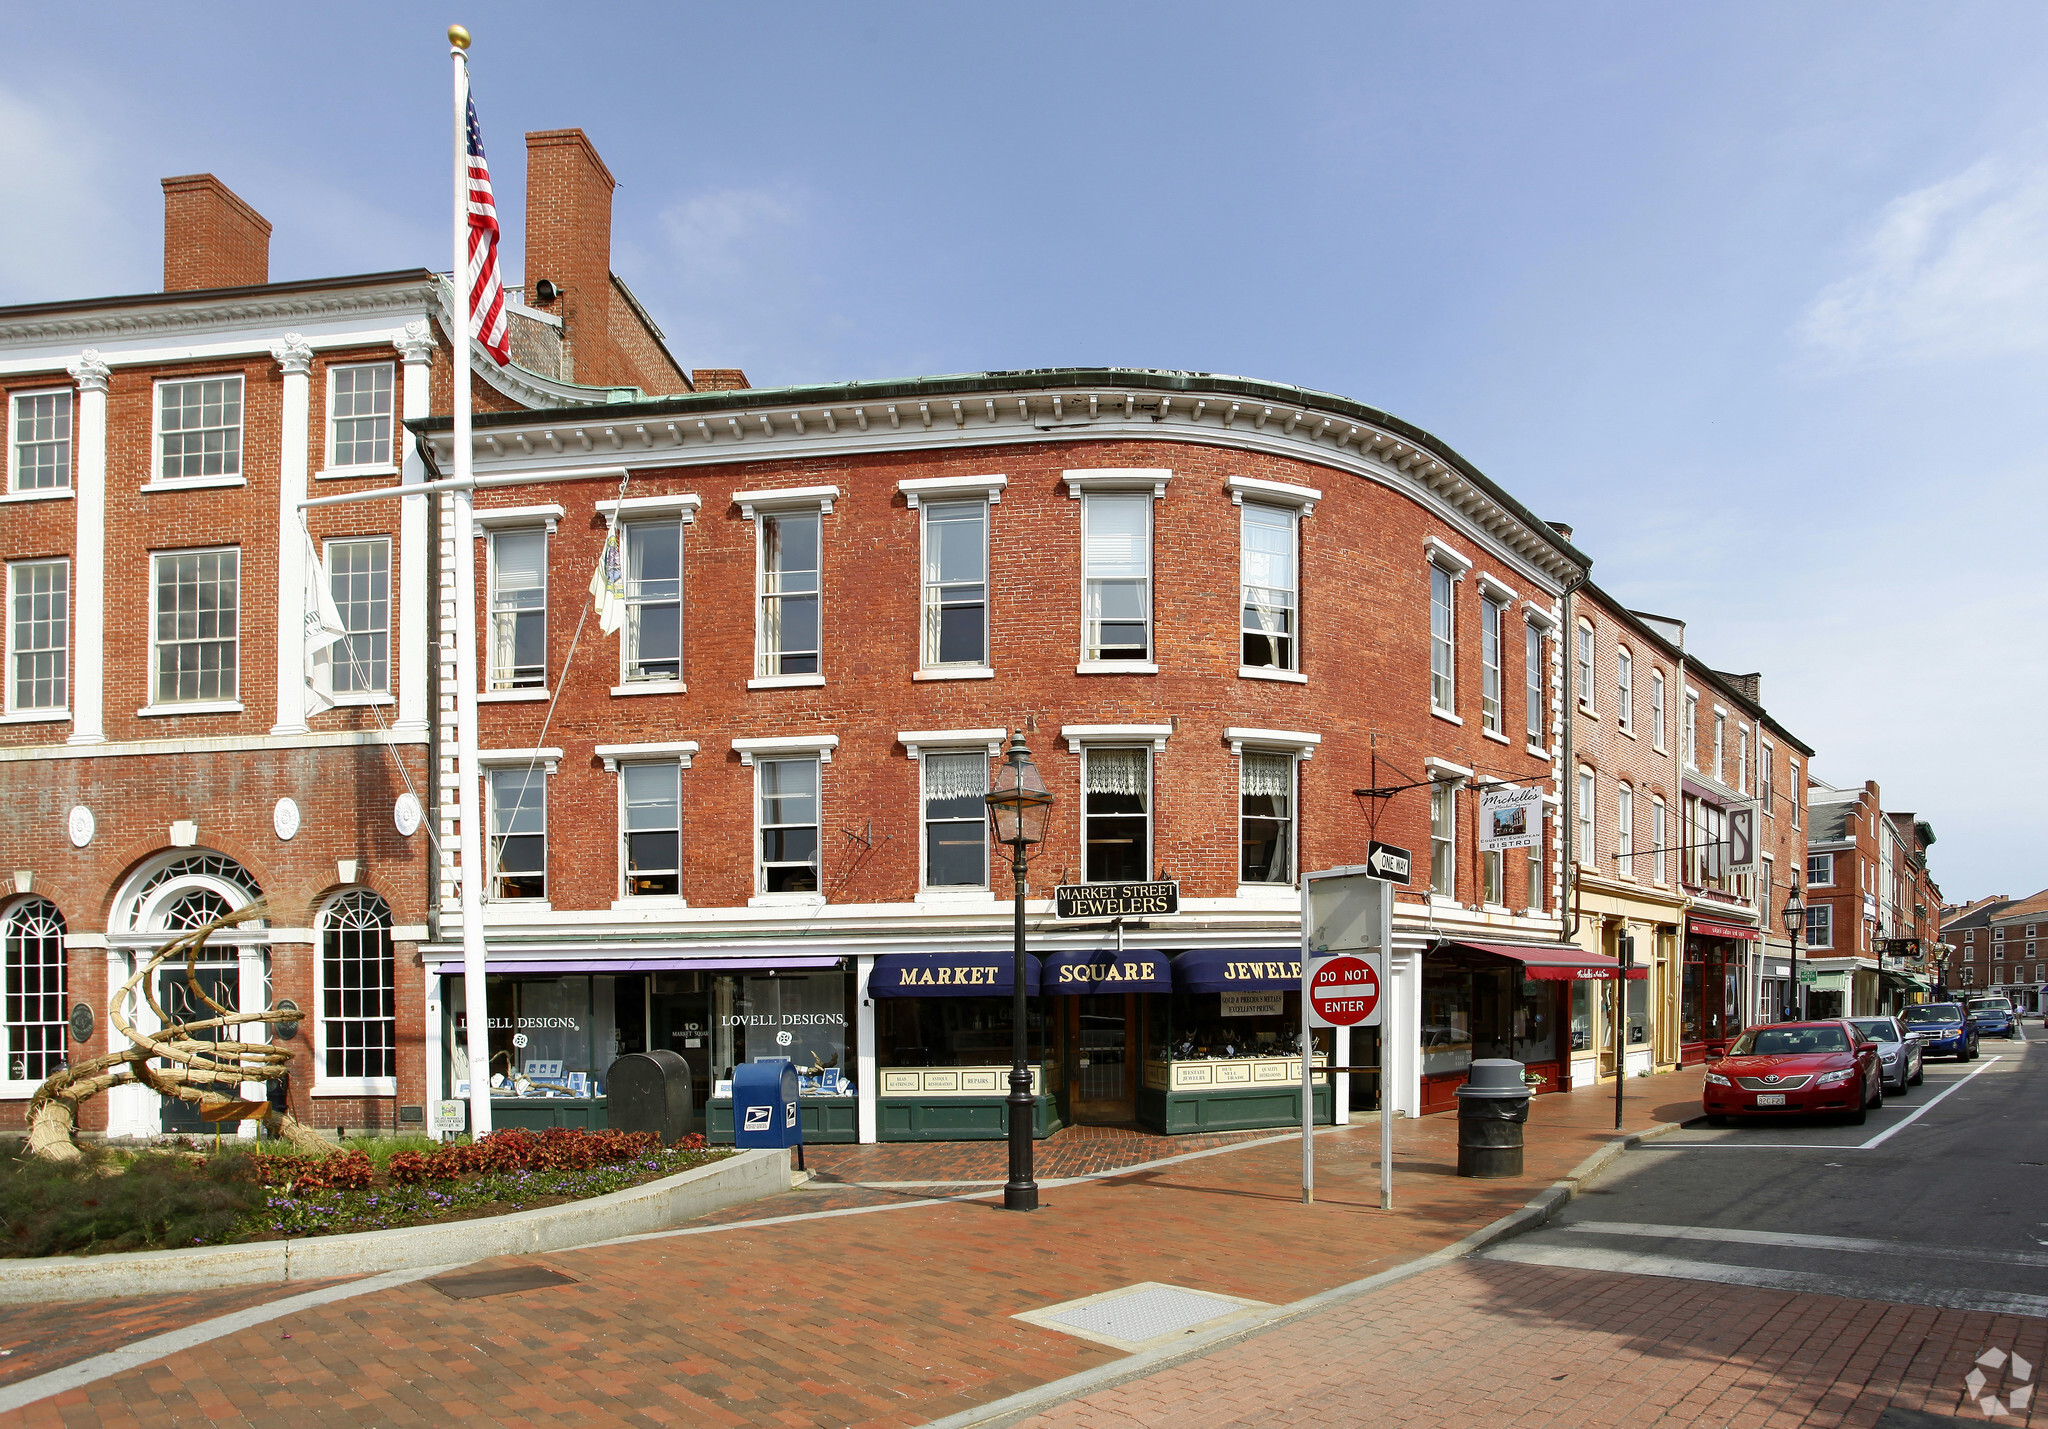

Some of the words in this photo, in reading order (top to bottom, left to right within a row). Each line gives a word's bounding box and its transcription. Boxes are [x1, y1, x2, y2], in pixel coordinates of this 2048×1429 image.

[1481, 788, 1540, 806] Michelle's
[1508, 833, 1540, 841] EUROPEAN
[1489, 839, 1531, 849] BISTRO
[1382, 854, 1394, 870] ONE
[1395, 857, 1407, 875] WAY
[1059, 886, 1118, 901] MARKET
[1122, 883, 1176, 898] STREET
[1068, 896, 1168, 916] JEWELERS
[899, 966, 999, 985] MARKET
[1059, 962, 1154, 982] SQUARE
[1223, 961, 1302, 981] JEWELE
[1320, 970, 1336, 982] DO
[1344, 969, 1369, 981] NOT
[1229, 1005, 1255, 1013] EXCELLENT
[1325, 1000, 1364, 1013] ENTER
[460, 1017, 513, 1029] LELL
[684, 1022, 699, 1031] 10
[722, 1015, 777, 1026] LOVELL
